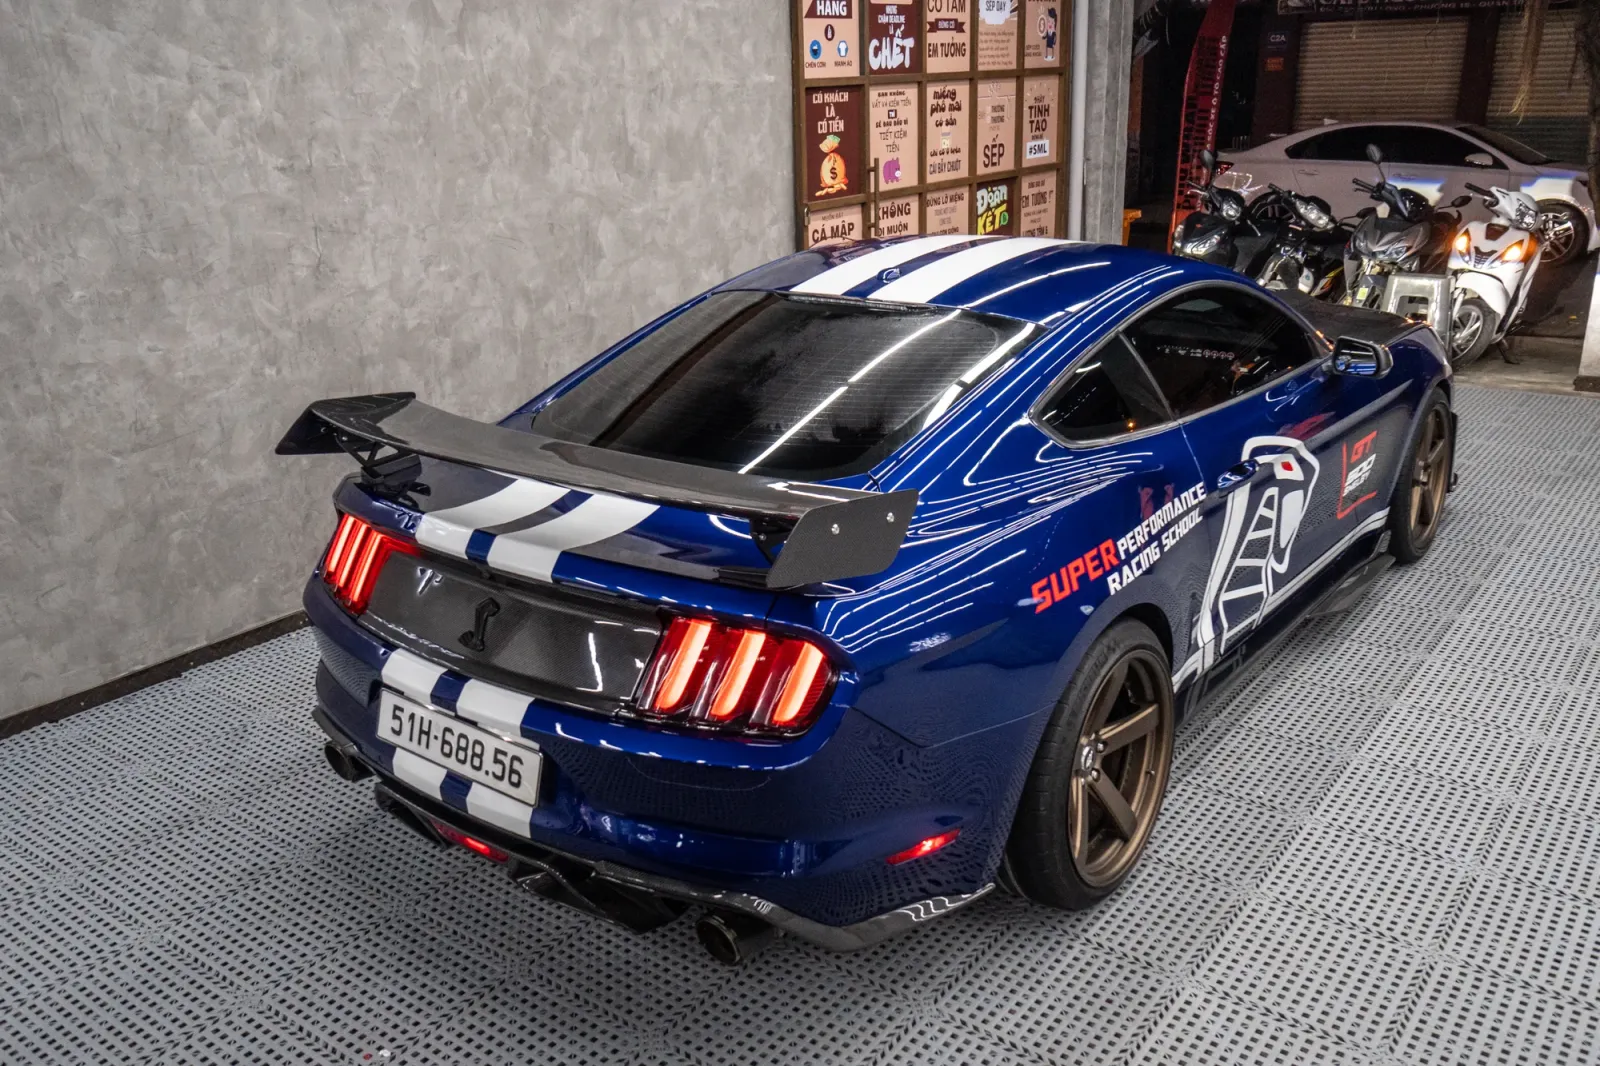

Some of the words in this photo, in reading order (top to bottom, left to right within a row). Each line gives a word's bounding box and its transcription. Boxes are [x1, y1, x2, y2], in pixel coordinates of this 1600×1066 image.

[869, 24, 915, 70] CHẾT
[928, 42, 938, 58] EM
[940, 37, 966, 58] TƯỞNG
[1270, 34, 1286, 43] C2A
[813, 91, 822, 104] CÓ
[824, 90, 848, 102] KHÁCH
[826, 104, 836, 118] LÀ
[818, 118, 828, 134] CÓ
[983, 134, 1004, 168] SẾP
[1029, 143, 1047, 155] #SML
[812, 224, 827, 243] CÁ
[830, 220, 854, 240] MẬP
[887, 222, 908, 235] MUỘN
[1031, 538, 1120, 614] SUPER
[1116, 481, 1207, 560] PERFORMANCE
[1106, 540, 1161, 596] RACING
[1161, 507, 1204, 552] SCHOOL
[391, 704, 524, 789] 51H-688.56
